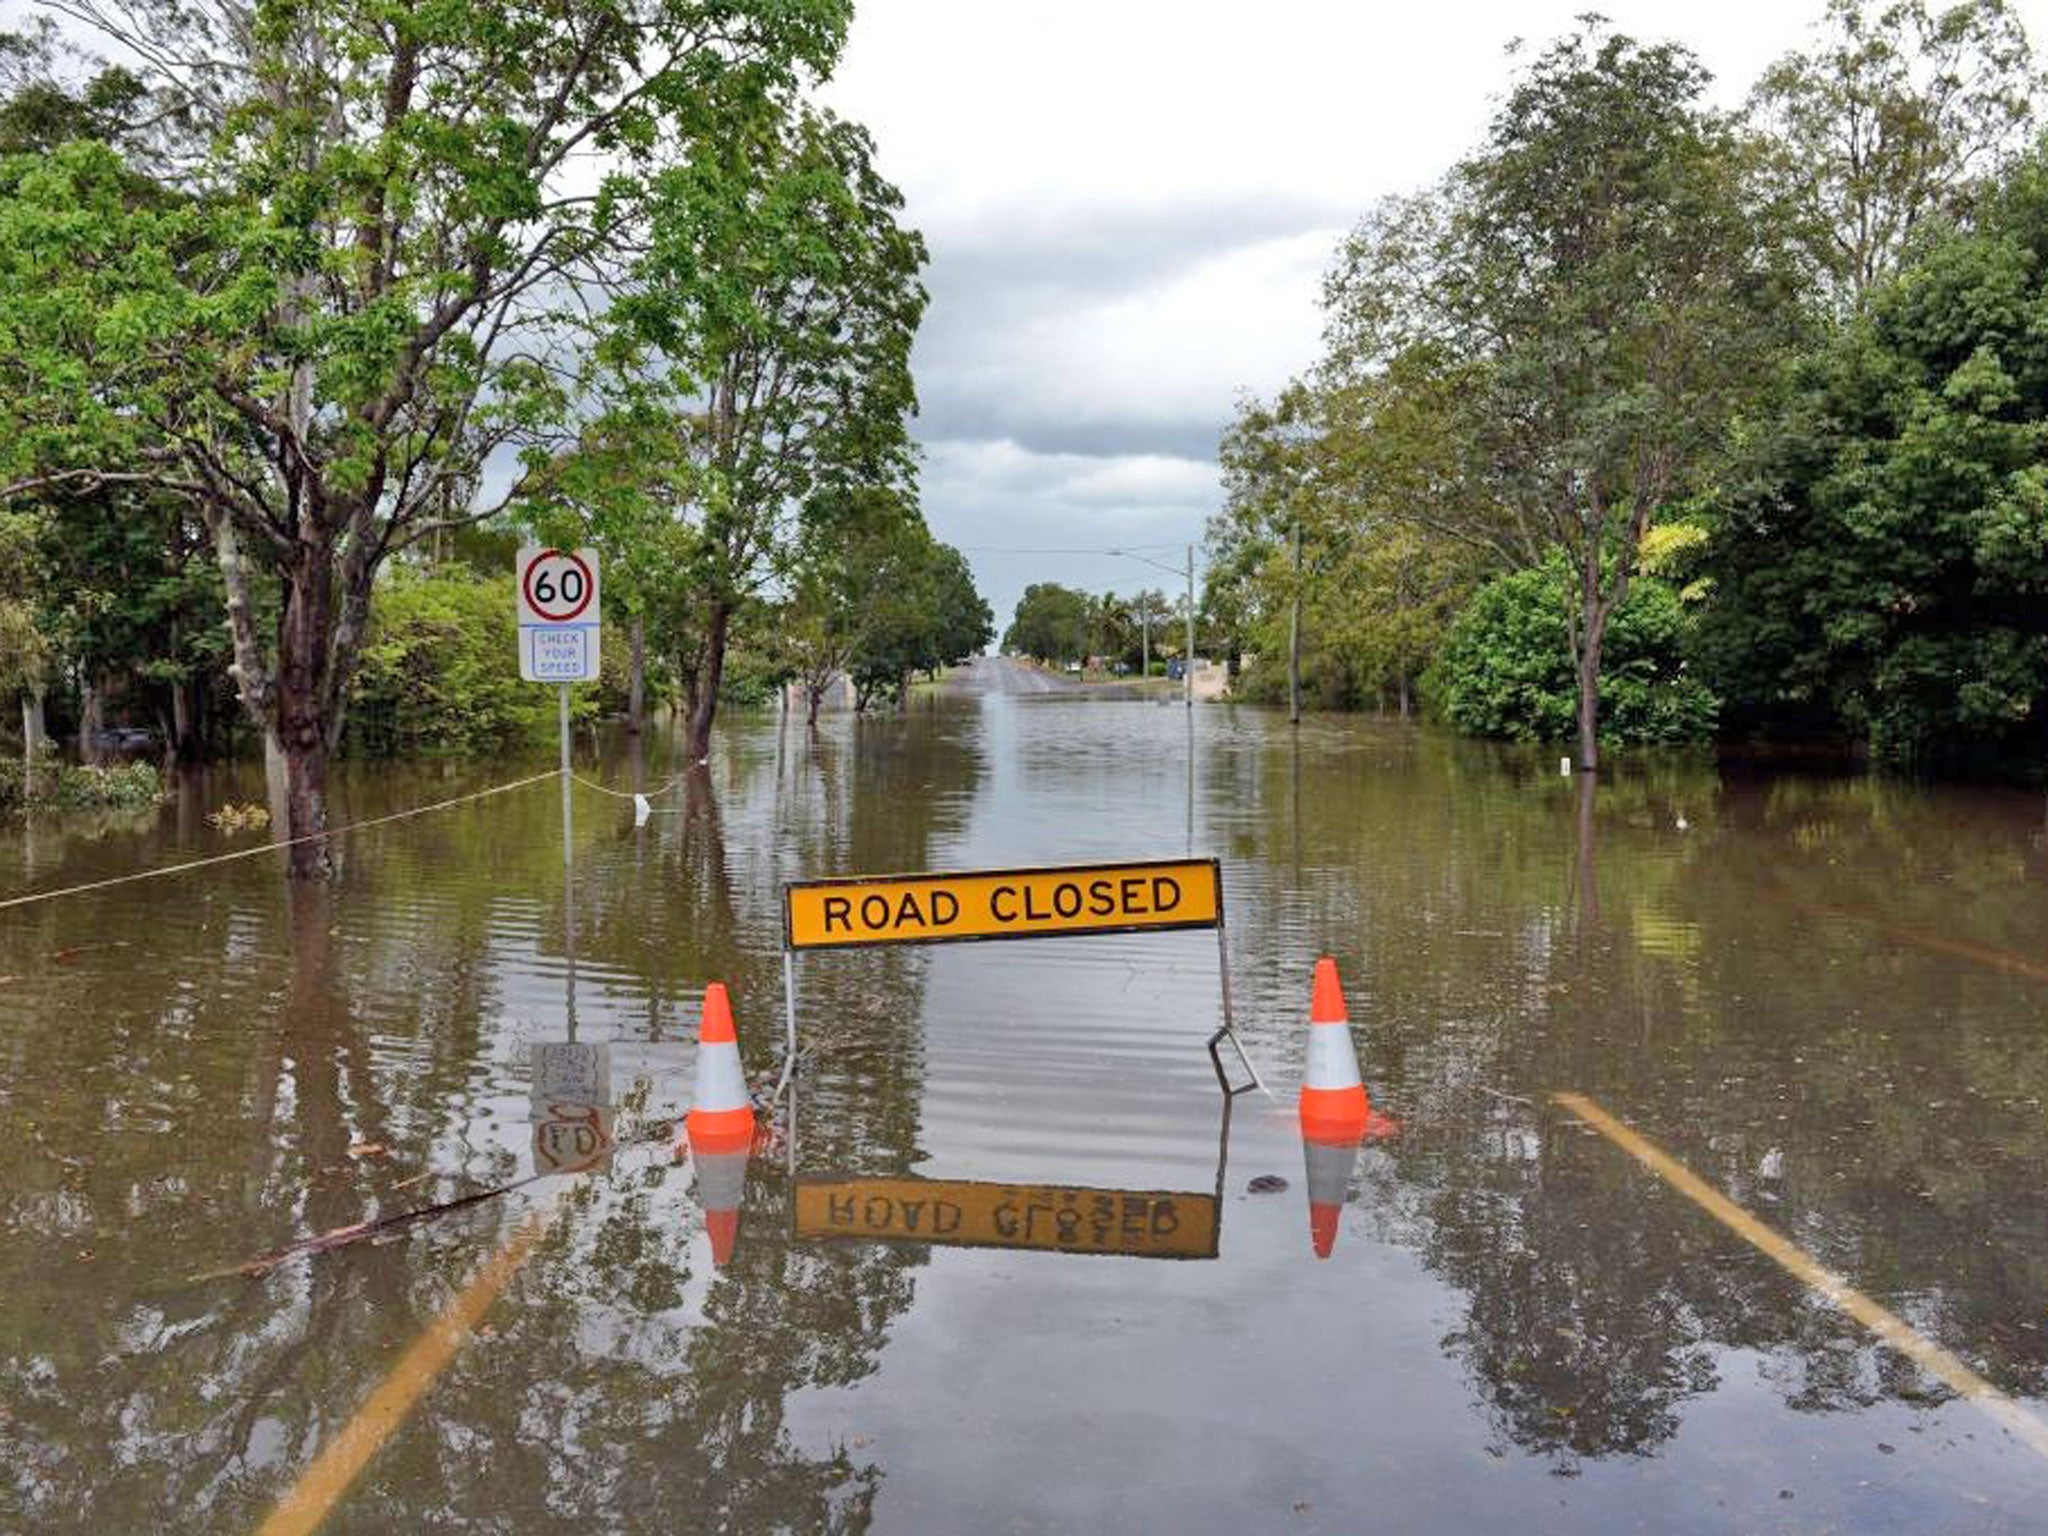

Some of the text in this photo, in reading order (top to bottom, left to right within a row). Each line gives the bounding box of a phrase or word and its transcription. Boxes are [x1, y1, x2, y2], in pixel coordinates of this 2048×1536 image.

[534, 570, 582, 603] 60
[540, 632, 579, 645] CHECK
[545, 648, 577, 659] YOUR
[541, 661, 580, 673] SPEED
[824, 877, 1181, 932] ROAD CLOSED
